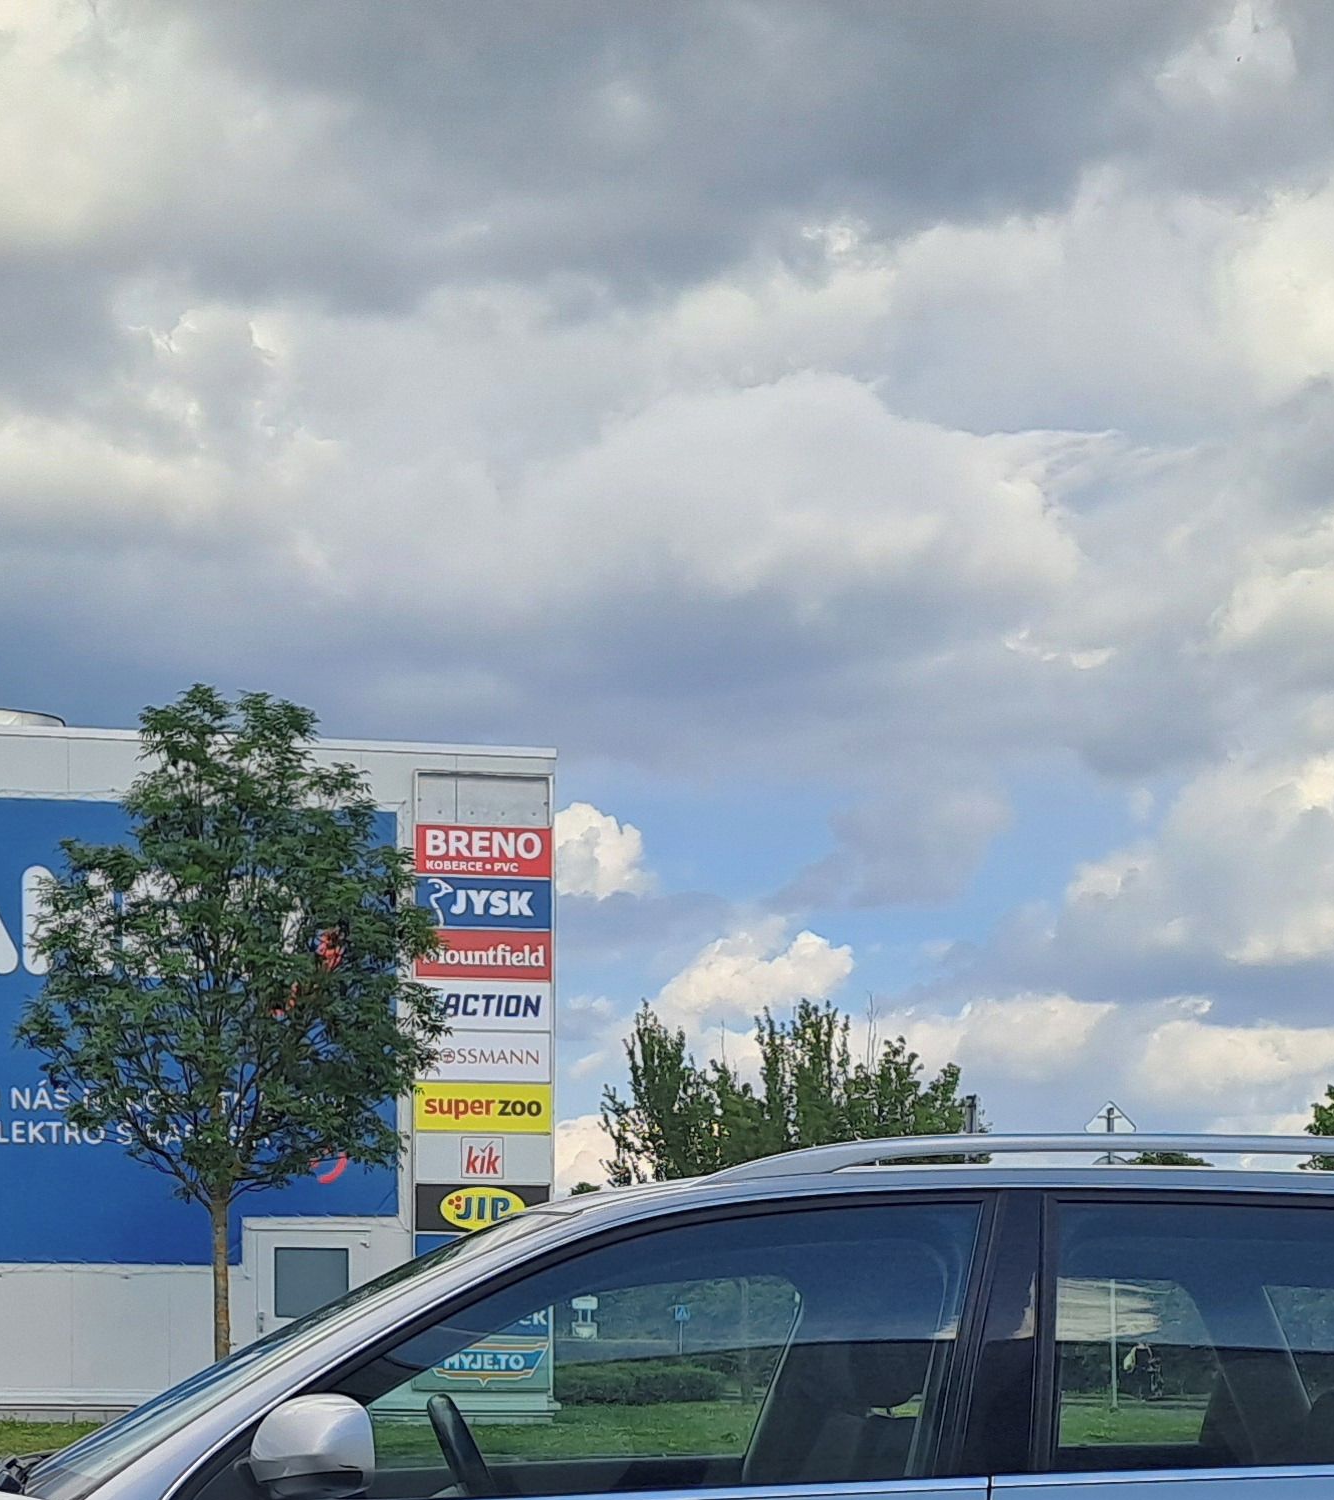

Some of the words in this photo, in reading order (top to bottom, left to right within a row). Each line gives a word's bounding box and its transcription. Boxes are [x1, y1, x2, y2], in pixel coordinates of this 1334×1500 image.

[425, 829, 542, 860] BRENO
[426, 860, 483, 871] KOBERCE
[493, 863, 519, 872] PVC
[450, 889, 534, 916] JYSK
[441, 993, 542, 1018] ACTION
[11, 1079, 70, 1110] NÁS
[424, 1098, 495, 1121] super
[497, 1099, 543, 1117] zoo
[465, 1145, 500, 1174] kik
[455, 1196, 511, 1221] JIP
[443, 1353, 525, 1370] MYJE.TO
